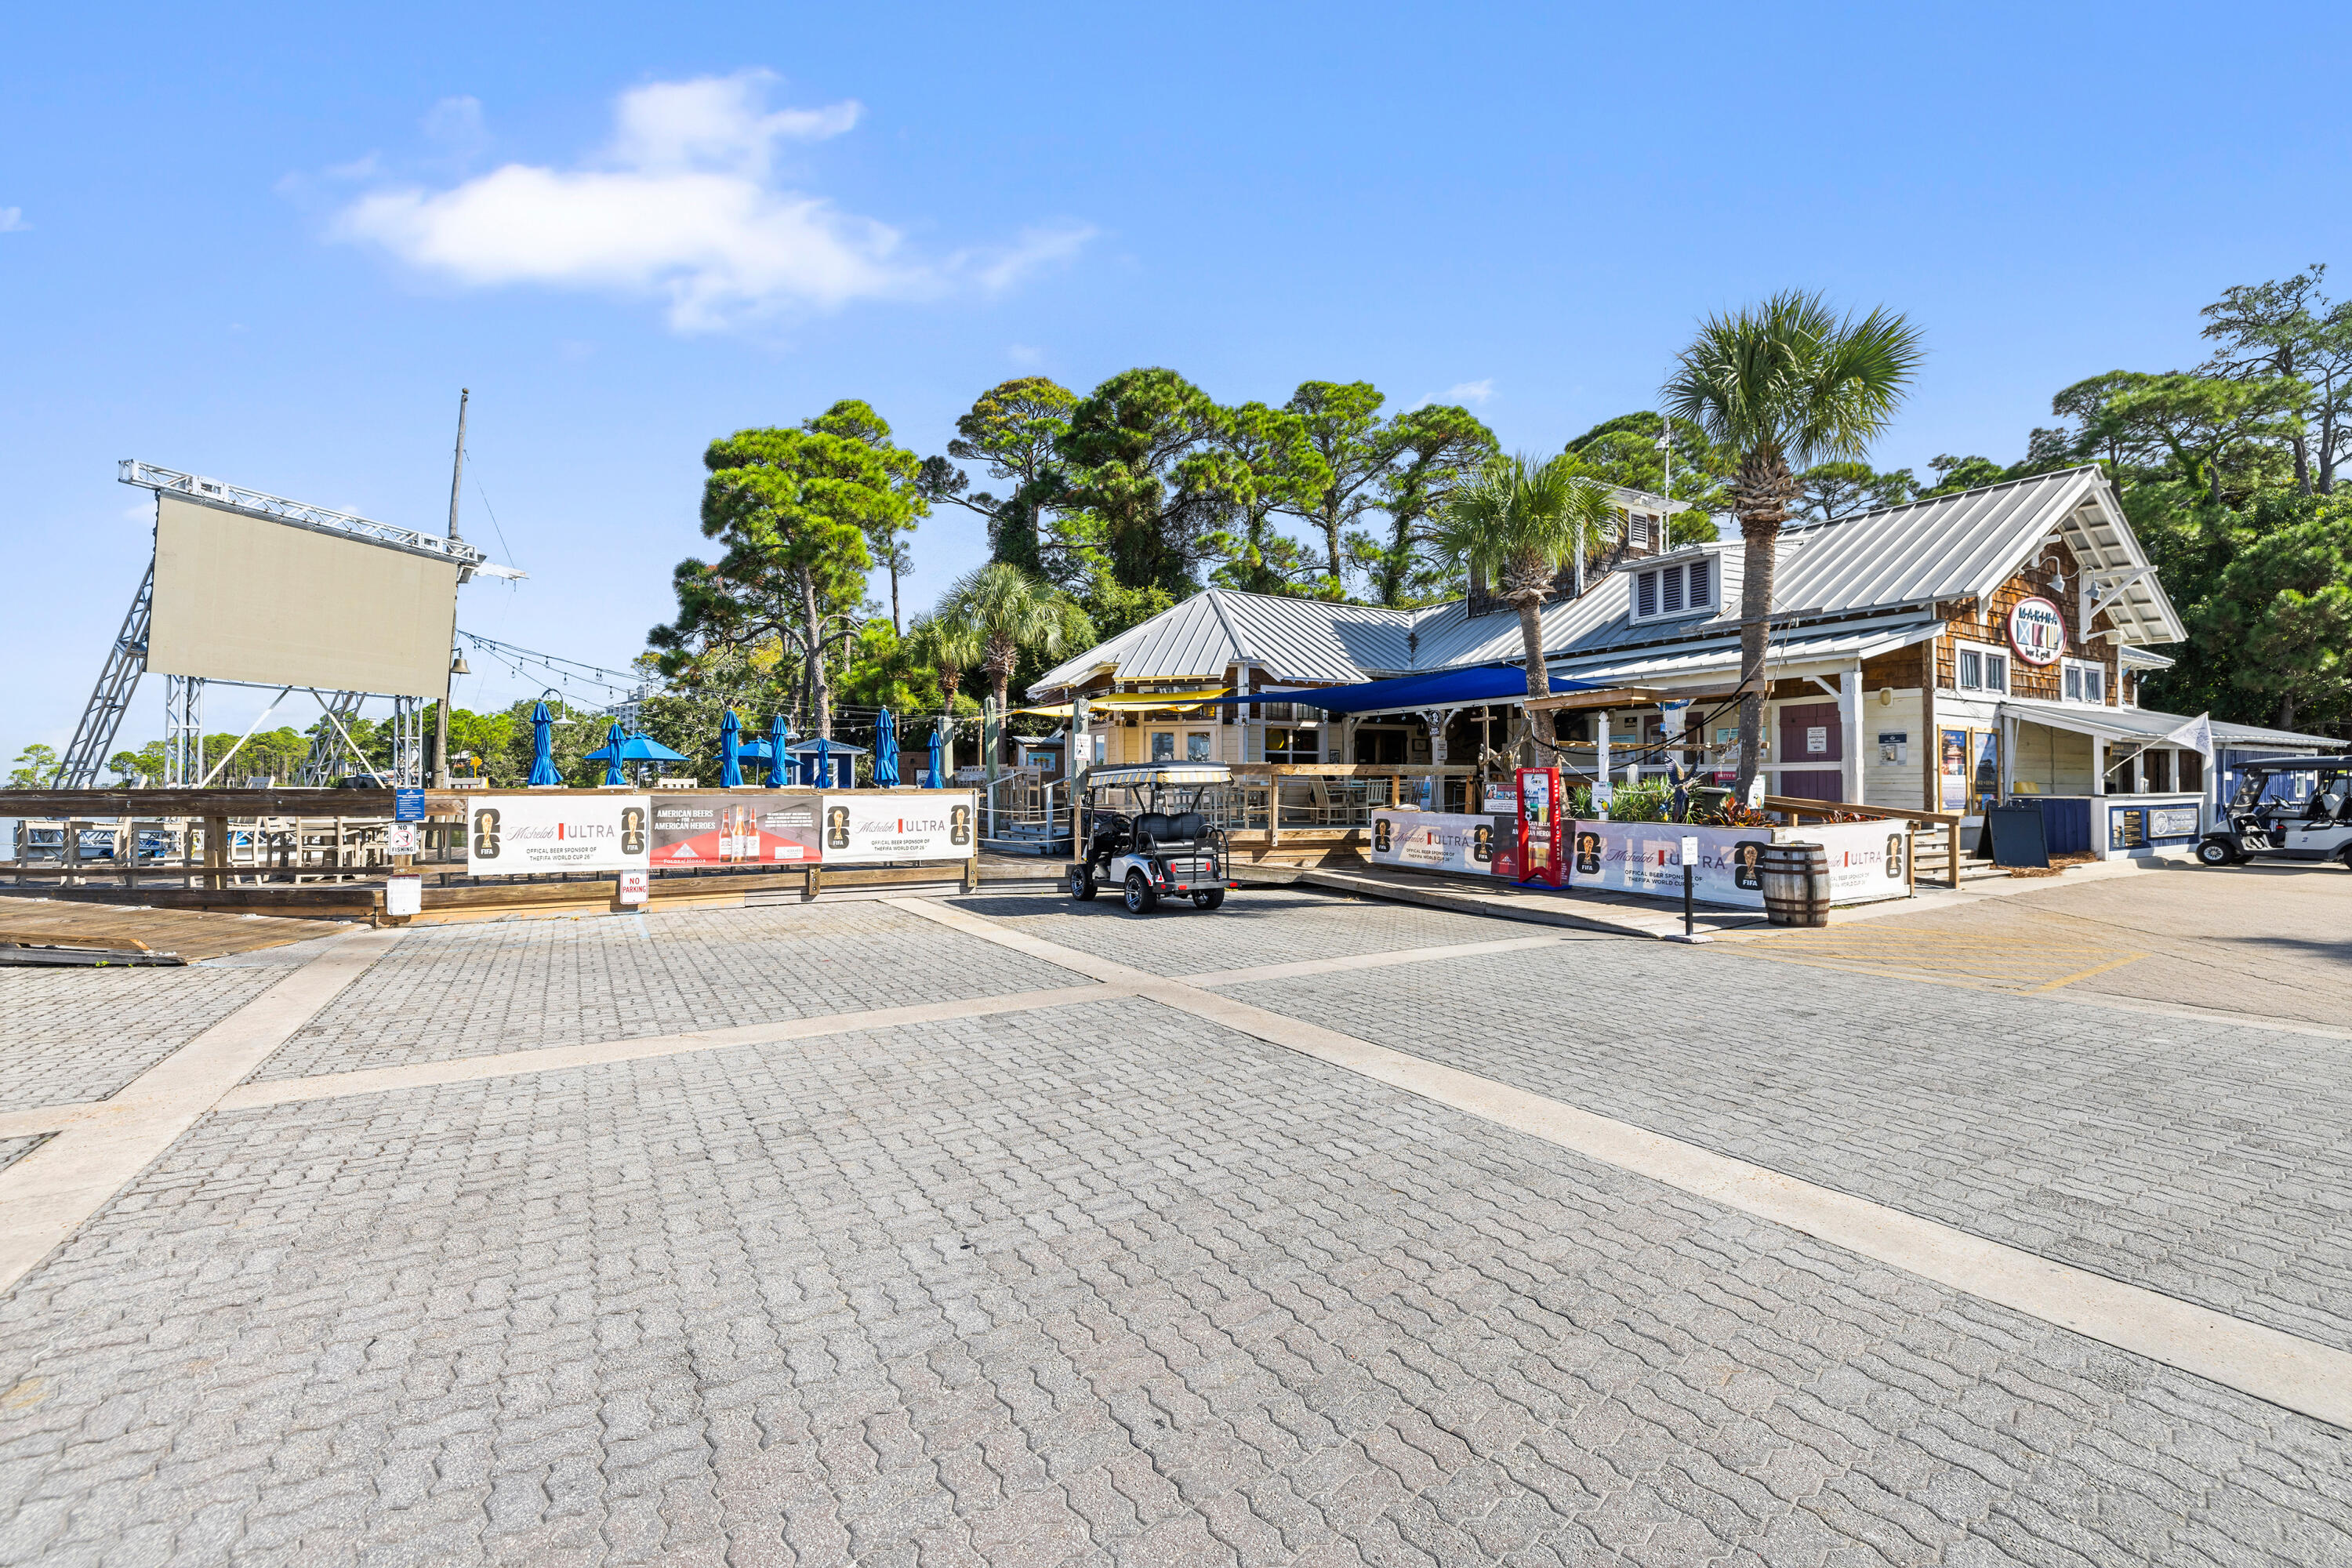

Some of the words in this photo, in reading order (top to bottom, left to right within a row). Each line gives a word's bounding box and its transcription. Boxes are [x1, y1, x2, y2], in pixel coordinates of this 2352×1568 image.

[655, 822, 688, 830] AMERICAN
[689, 821, 716, 829] HEROES
[855, 821, 895, 834] Michelob
[906, 820, 946, 832] ULTRA
[506, 826, 554, 841] Michelob
[568, 825, 615, 838] ULTRA
[1393, 832, 1425, 843] Michelob
[1434, 835, 1469, 847] ULTRA
[1606, 848, 1655, 863] Michelob
[1669, 853, 1726, 869] URA
[1851, 851, 1882, 865] ULTRA
